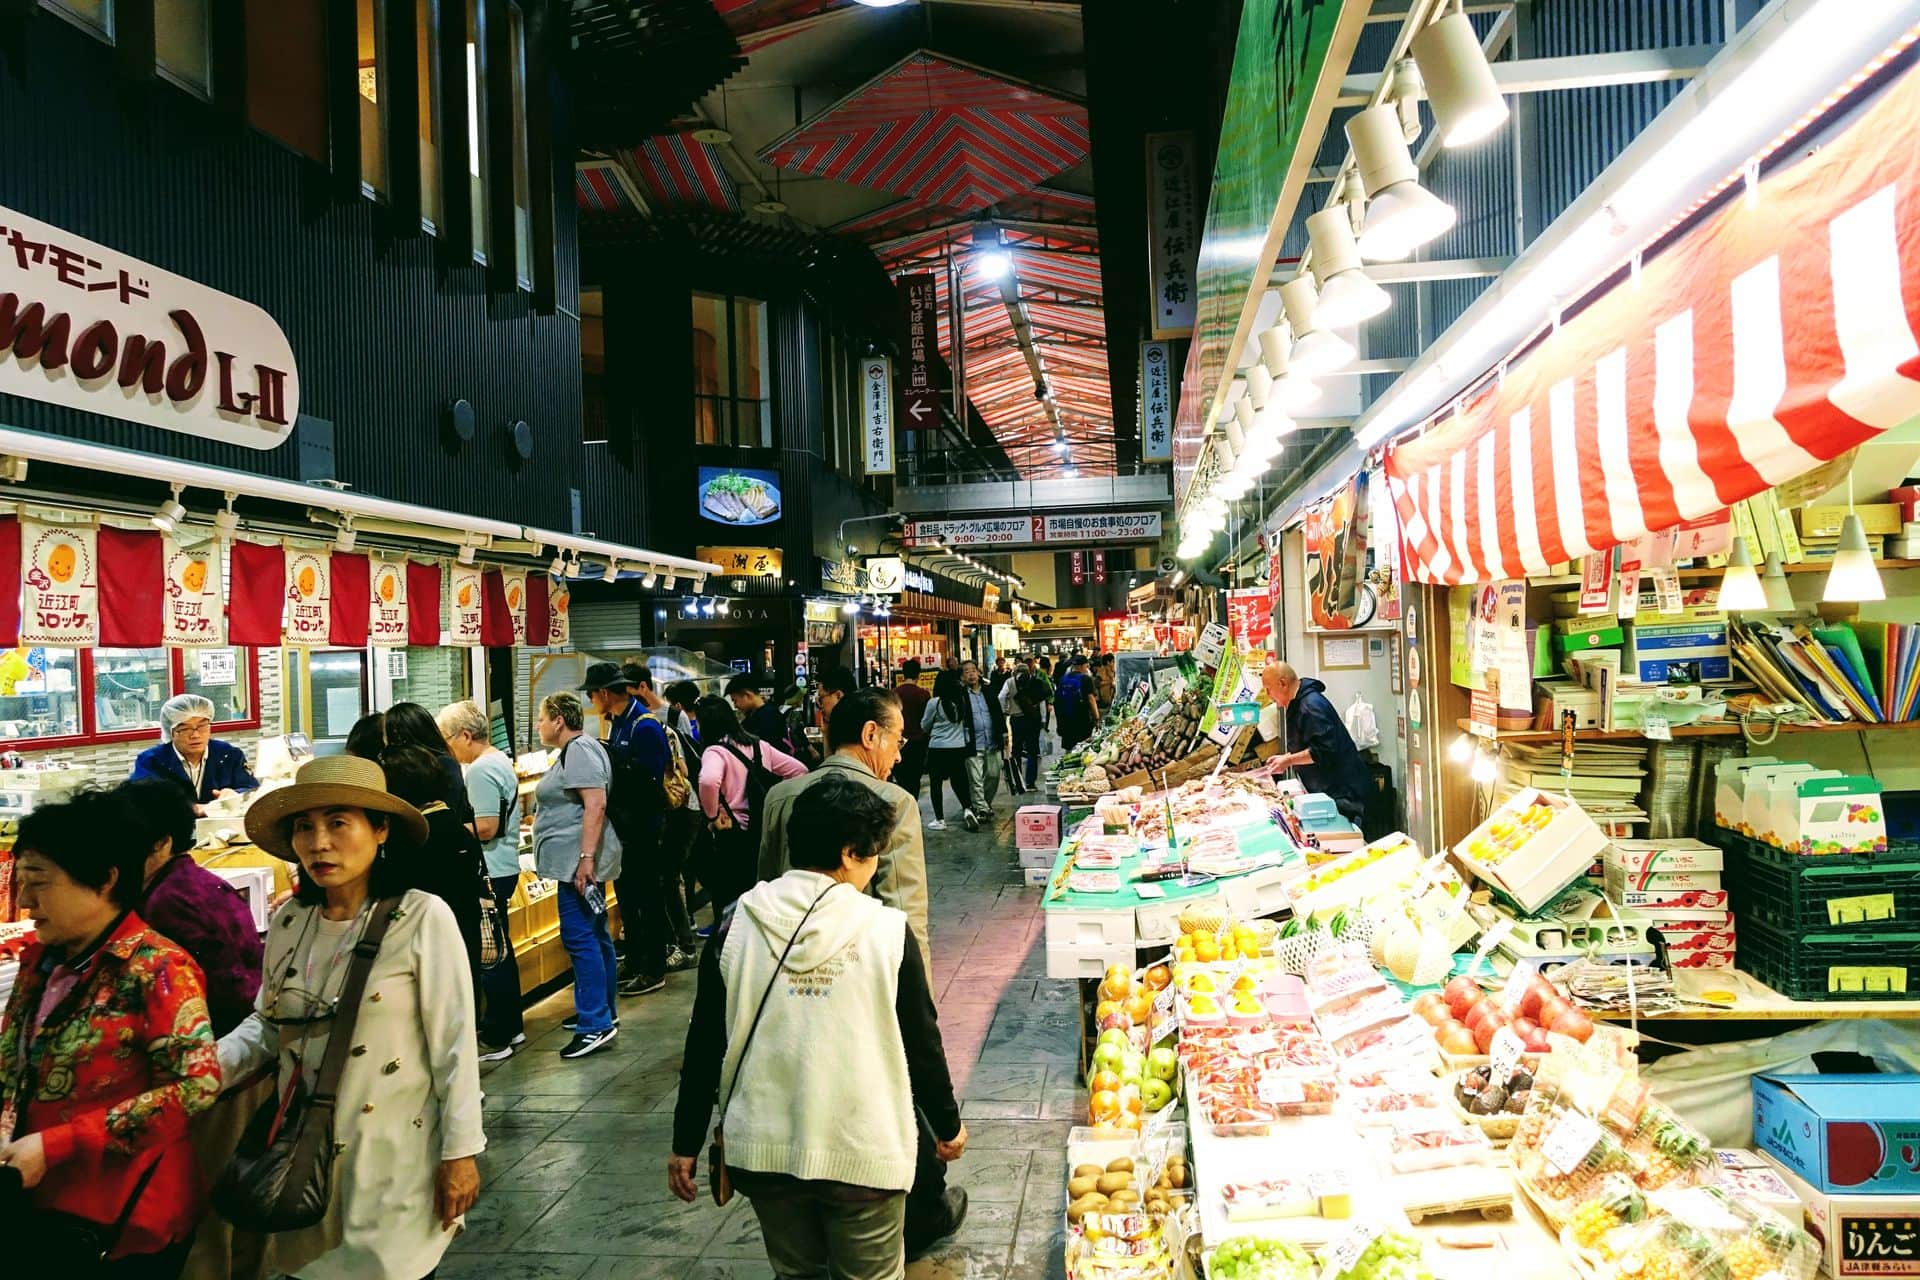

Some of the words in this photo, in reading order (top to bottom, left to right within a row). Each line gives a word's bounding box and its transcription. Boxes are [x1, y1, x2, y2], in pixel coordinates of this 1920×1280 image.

[0, 226, 149, 304] ヤモンド
[909, 285, 926, 362] いちば館広場
[1150, 366, 1166, 443] 近江屋伝兵衛
[903, 524, 914, 537] B1
[1033, 518, 1043, 531] 2
[1049, 515, 1157, 530] 市場自慢のお食事処のフロア
[39, 594, 80, 611] 近江町
[295, 605, 322, 618] 近江町
[37, 612, 88, 629] コロッケ
[375, 622, 404, 633] コロッケ
[1848, 1231, 1917, 1257] りんご
